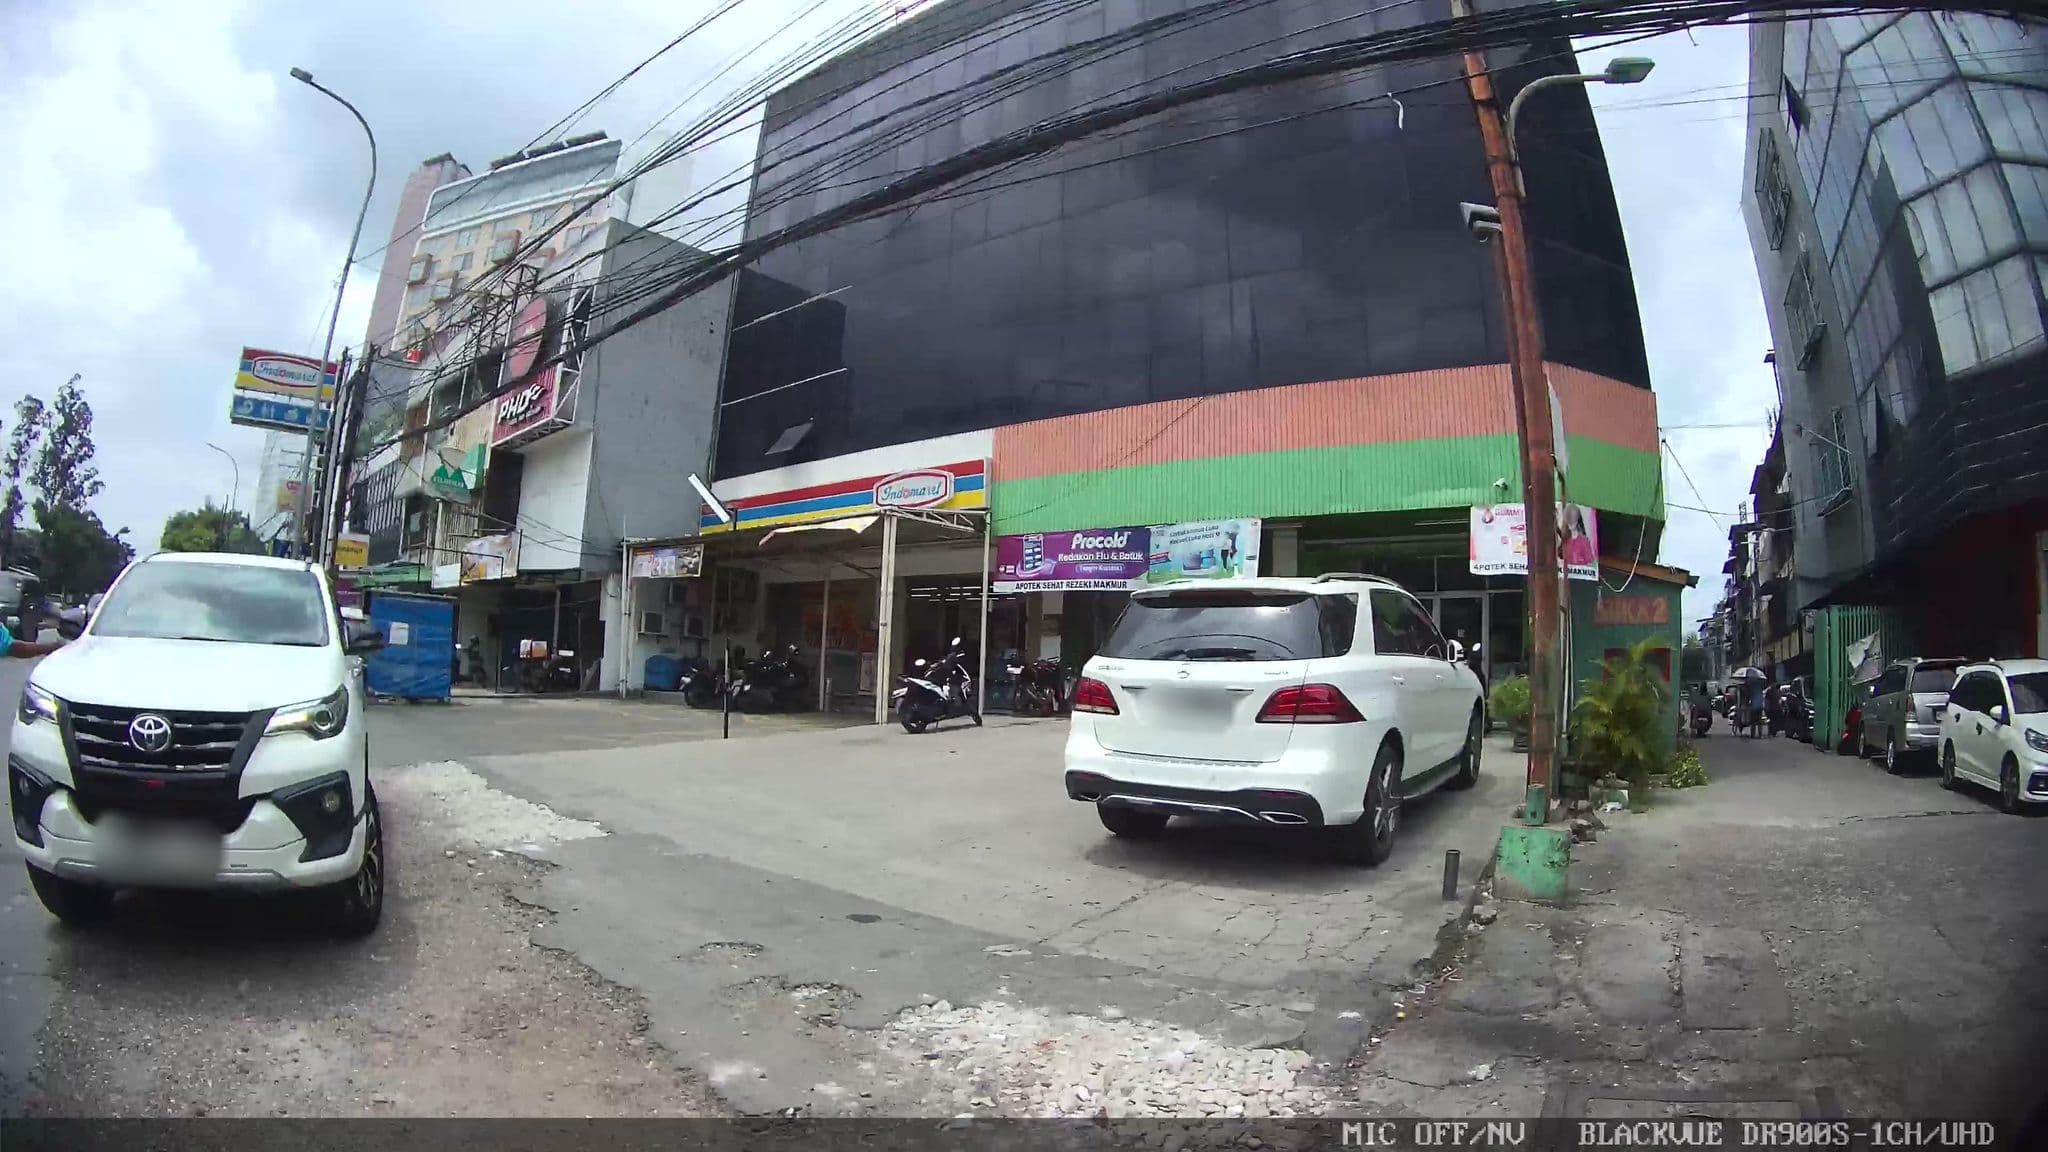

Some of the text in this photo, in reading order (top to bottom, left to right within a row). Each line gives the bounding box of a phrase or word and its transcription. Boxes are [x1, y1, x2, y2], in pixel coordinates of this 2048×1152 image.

[880, 481, 942, 500] Indomaret
[1071, 531, 1129, 549] Procold
[1058, 553, 1094, 562] Redakan
[1096, 552, 1109, 560] Flu
[1111, 552, 1117, 560] &
[1120, 551, 1144, 560] Batuk
[1474, 562, 1529, 571] APOTEK SEHA
[1015, 582, 1040, 590] APOTEK
[1066, 581, 1091, 589] REZEKI
[1093, 580, 1128, 589] MAKMUR
